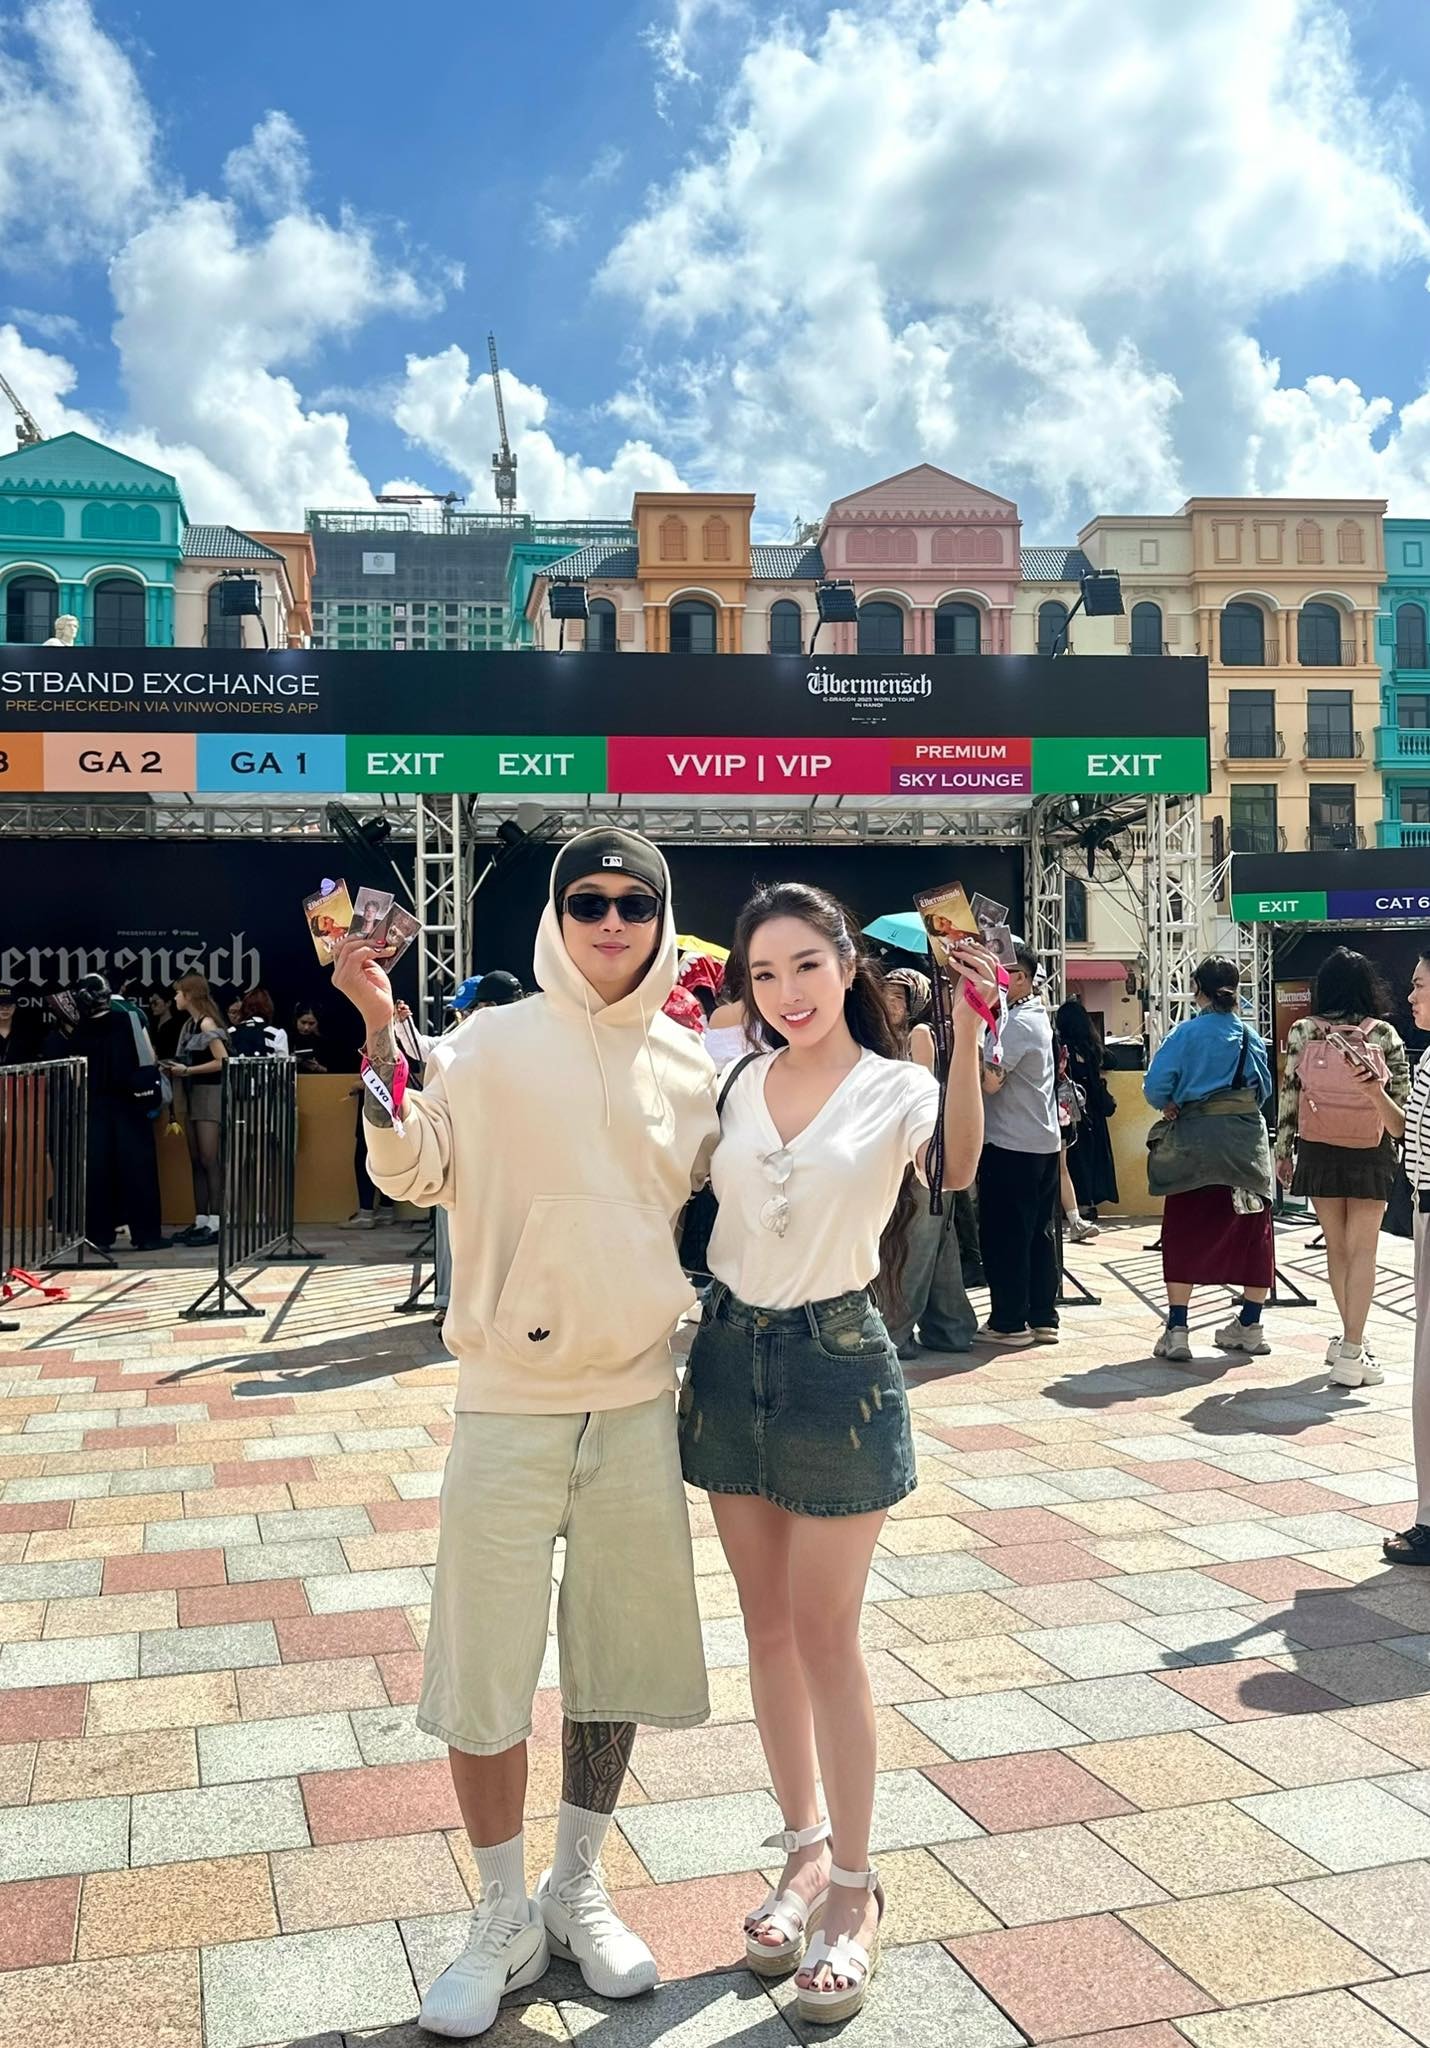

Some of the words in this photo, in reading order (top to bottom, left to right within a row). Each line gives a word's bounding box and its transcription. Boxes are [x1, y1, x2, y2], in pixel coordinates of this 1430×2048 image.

[144, 673, 319, 695] EXCHANGE
[806, 666, 932, 698] Übermensch
[6, 700, 140, 712] PRE-CHECKED-IN
[144, 701, 169, 712] VIA
[173, 702, 284, 713] VINWONDERS
[287, 703, 318, 713] APP
[79, 751, 131, 773] GA
[141, 751, 162, 773] 2
[916, 746, 1006, 758] PREMIUM
[231, 752, 282, 773] GA
[297, 753, 305, 774] 1
[368, 753, 444, 775] EXIT
[499, 754, 574, 775] EXIT
[667, 755, 746, 776] VVIP
[776, 755, 831, 776] VIP
[1088, 754, 1161, 776] EXIT
[900, 774, 936, 786] SKY
[942, 774, 1023, 786] LOUNGE
[1259, 901, 1299, 912] EXIT
[1376, 897, 1414, 909] CAT
[1418, 897, 1430, 908] 6
